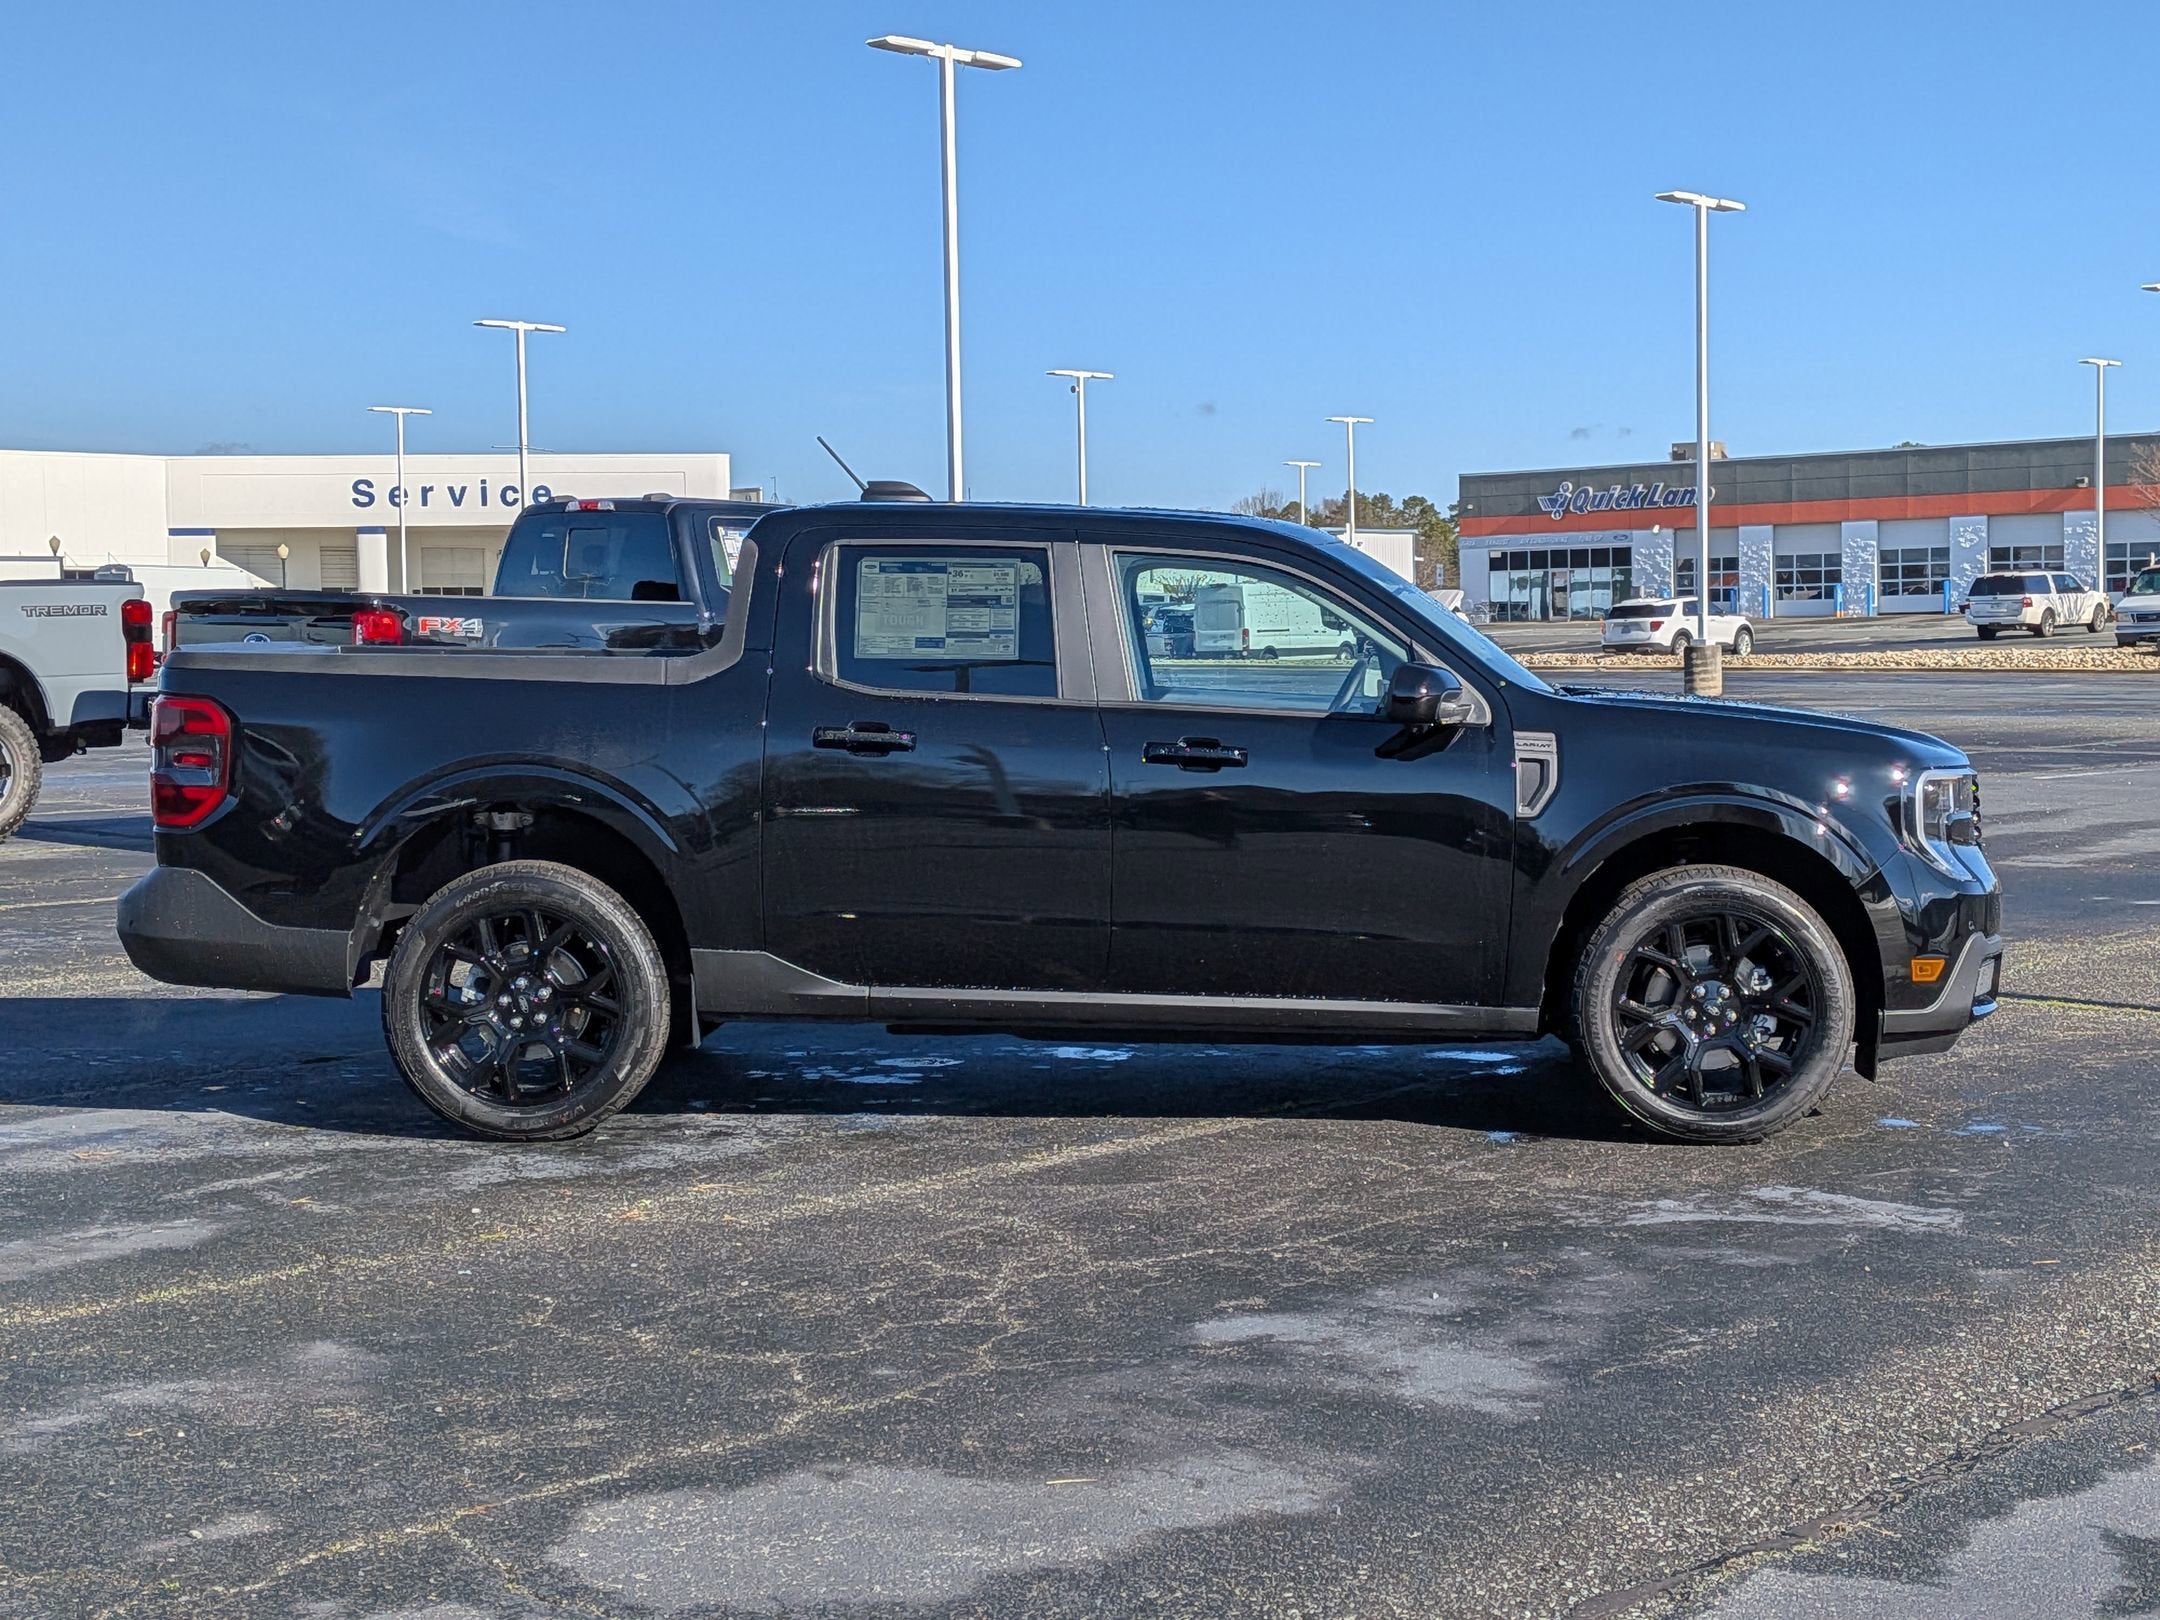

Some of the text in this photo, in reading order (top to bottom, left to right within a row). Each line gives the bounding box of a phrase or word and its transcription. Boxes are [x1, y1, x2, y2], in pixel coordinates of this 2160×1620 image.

[351, 478, 552, 508] Service
[1570, 482, 1716, 515] Quick Lan
[20, 604, 108, 618] TREMOR
[418, 616, 483, 637] FX4
[1515, 741, 1552, 749] LARIAT
